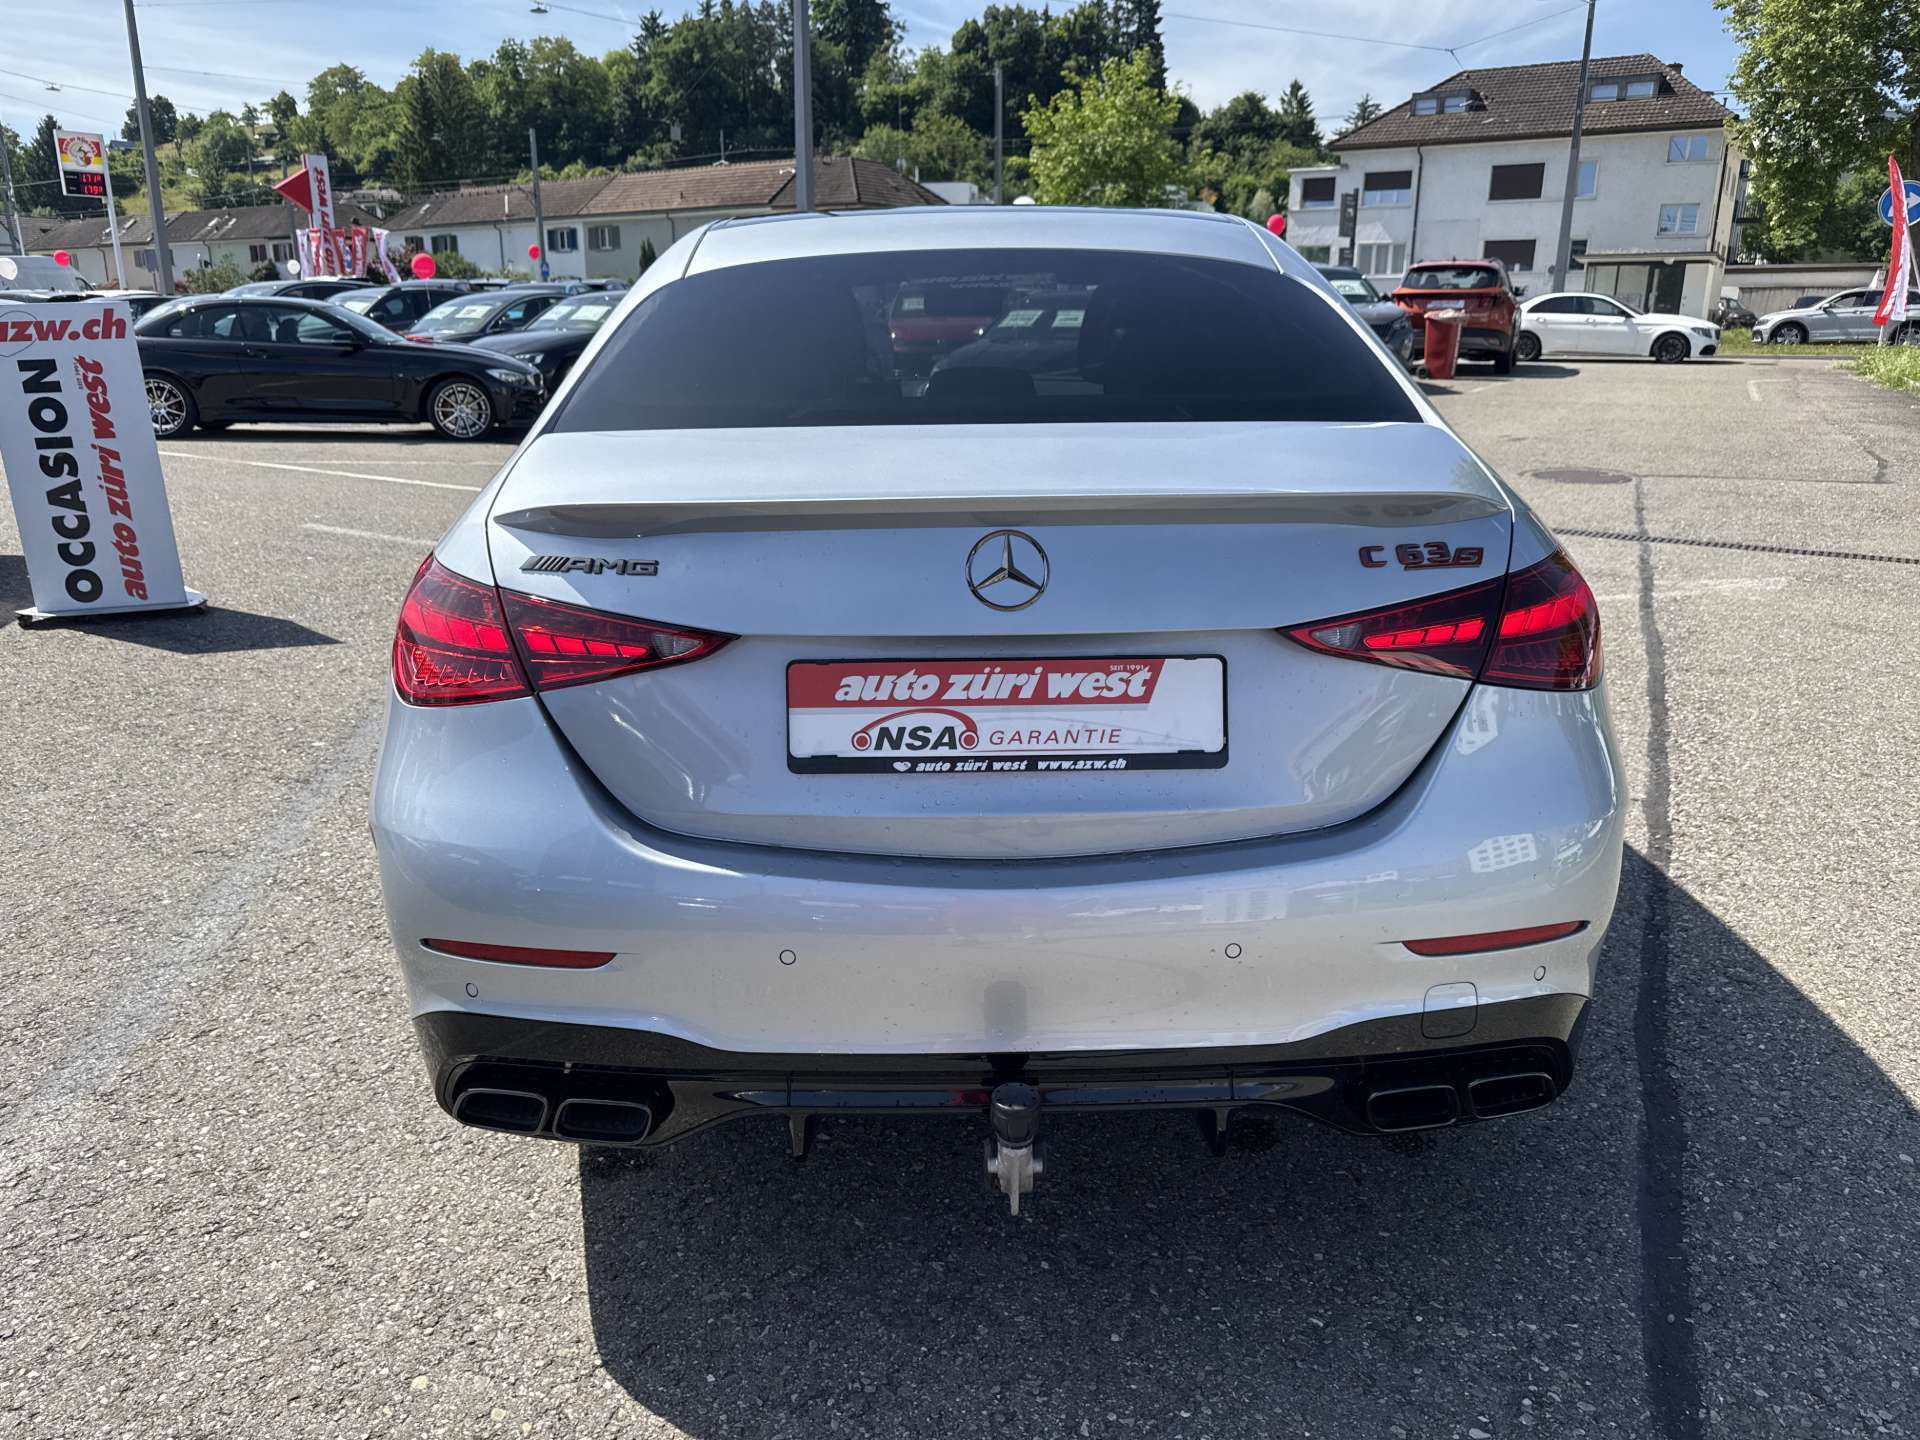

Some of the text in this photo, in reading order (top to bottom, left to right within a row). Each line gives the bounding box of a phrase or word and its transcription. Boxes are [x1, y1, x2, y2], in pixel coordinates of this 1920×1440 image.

[17, 359, 103, 603] OCCASION
[79, 355, 148, 600] auto züri west
[560, 556, 659, 576] AMG
[1358, 544, 1387, 568] C
[835, 665, 1152, 701] auto züri west
[874, 726, 1122, 751] NSA GARANTIE
[915, 758, 1127, 772] auto züri west www.azw.ch
